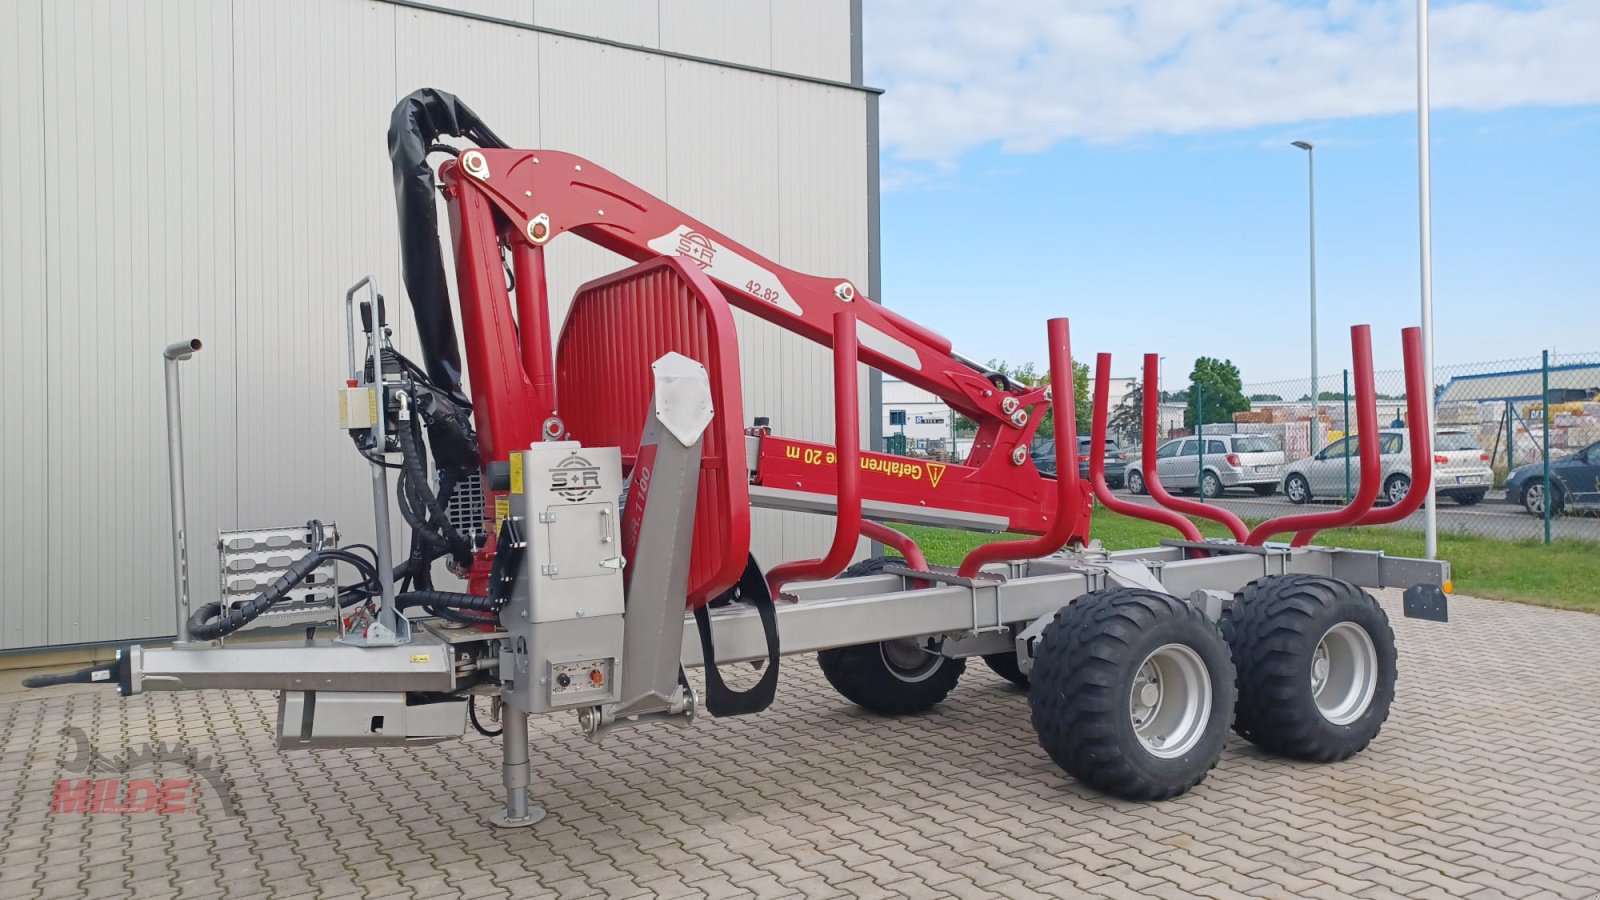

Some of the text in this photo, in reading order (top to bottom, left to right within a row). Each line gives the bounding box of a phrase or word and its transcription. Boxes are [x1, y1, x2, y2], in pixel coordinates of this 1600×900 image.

[745, 280, 779, 304] 42.82
[786, 445, 800, 459] m
[804, 448, 822, 465] 20
